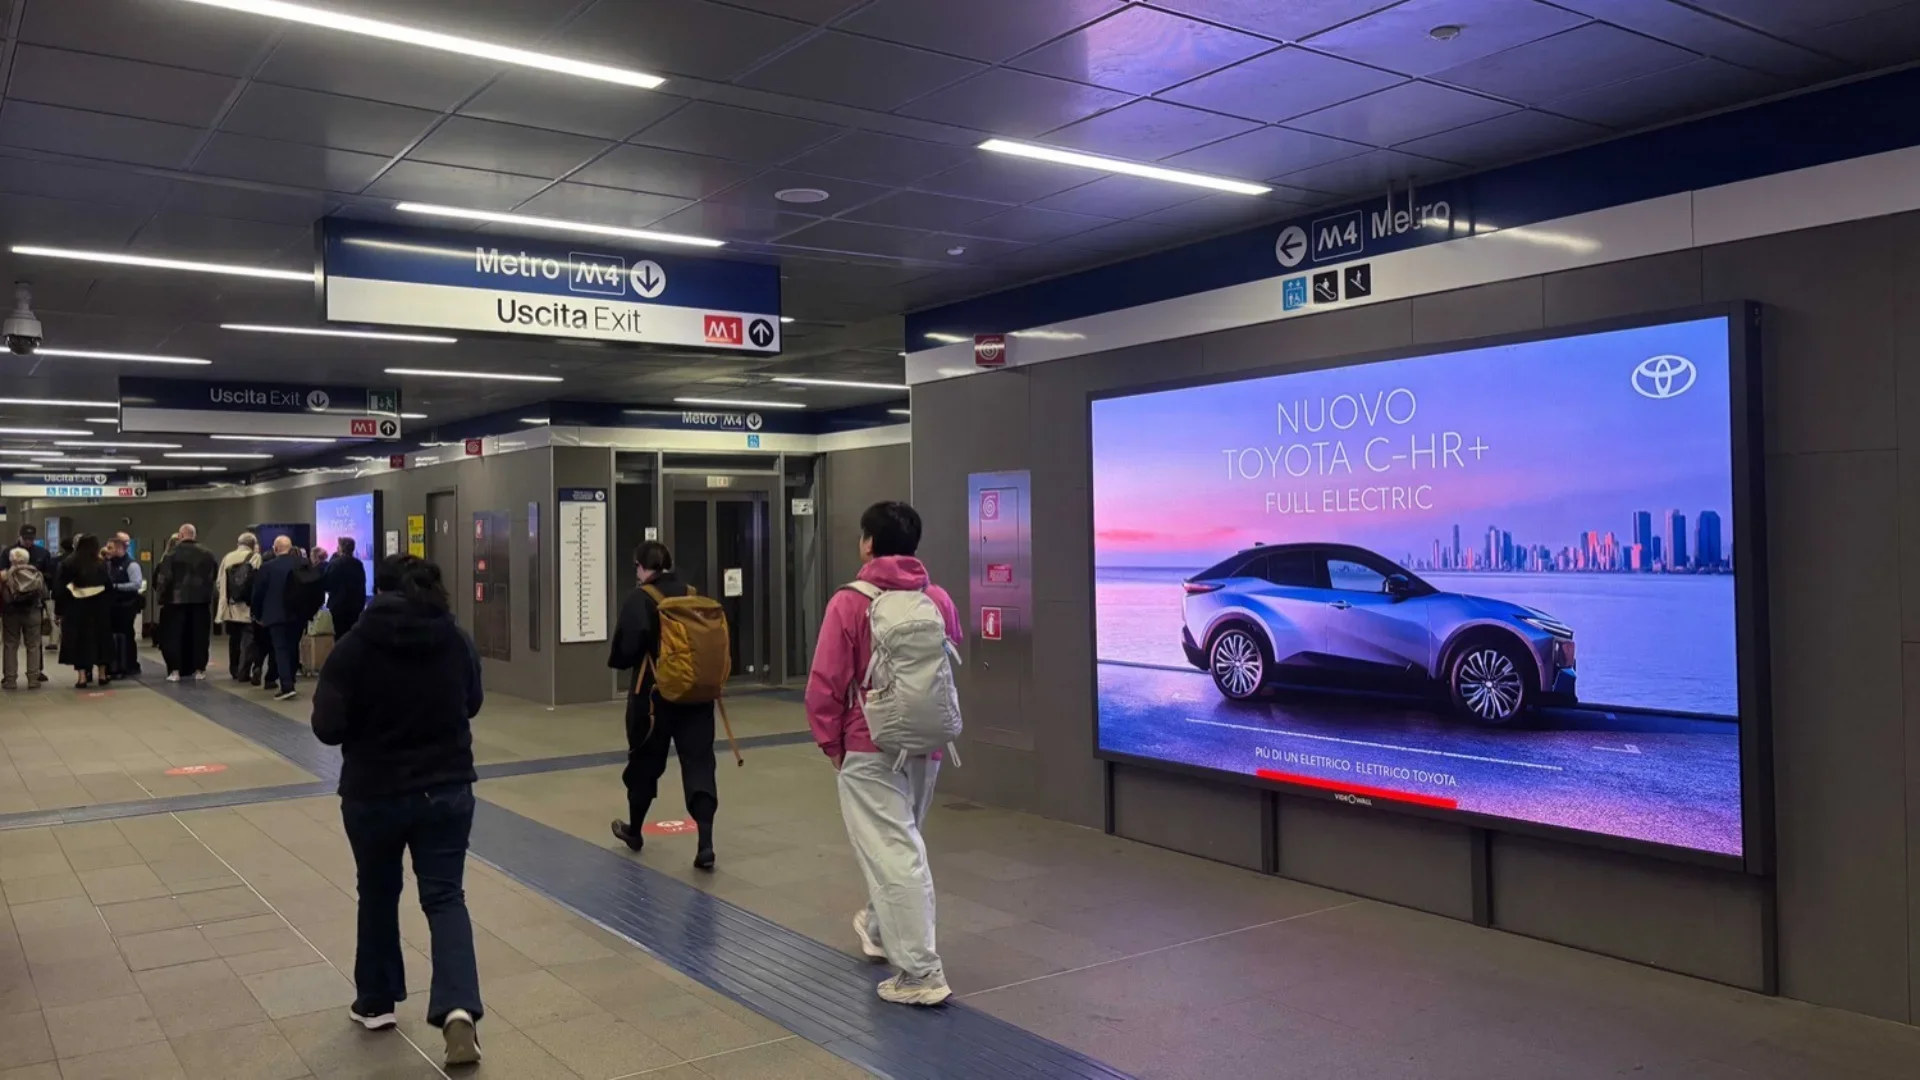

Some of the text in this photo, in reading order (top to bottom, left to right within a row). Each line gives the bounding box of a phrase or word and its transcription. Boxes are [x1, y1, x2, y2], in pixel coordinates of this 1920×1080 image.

[1317, 220, 1358, 251] M4
[475, 246, 619, 287] Metro M4
[497, 297, 642, 334] Uscita Exit
[708, 320, 738, 339] M1
[210, 388, 301, 406] Uscita Exit
[1277, 388, 1417, 435] NUOVO
[353, 422, 374, 433] M1
[681, 411, 742, 426] Metro M4
[1222, 431, 1489, 480] TOYOTA C-HR+
[1266, 484, 1433, 514] FULL ELECTRIC
[1271, 748, 1282, 761] DI
[1283, 751, 1299, 763] UN
[1356, 761, 1410, 780] ELETTRICO
